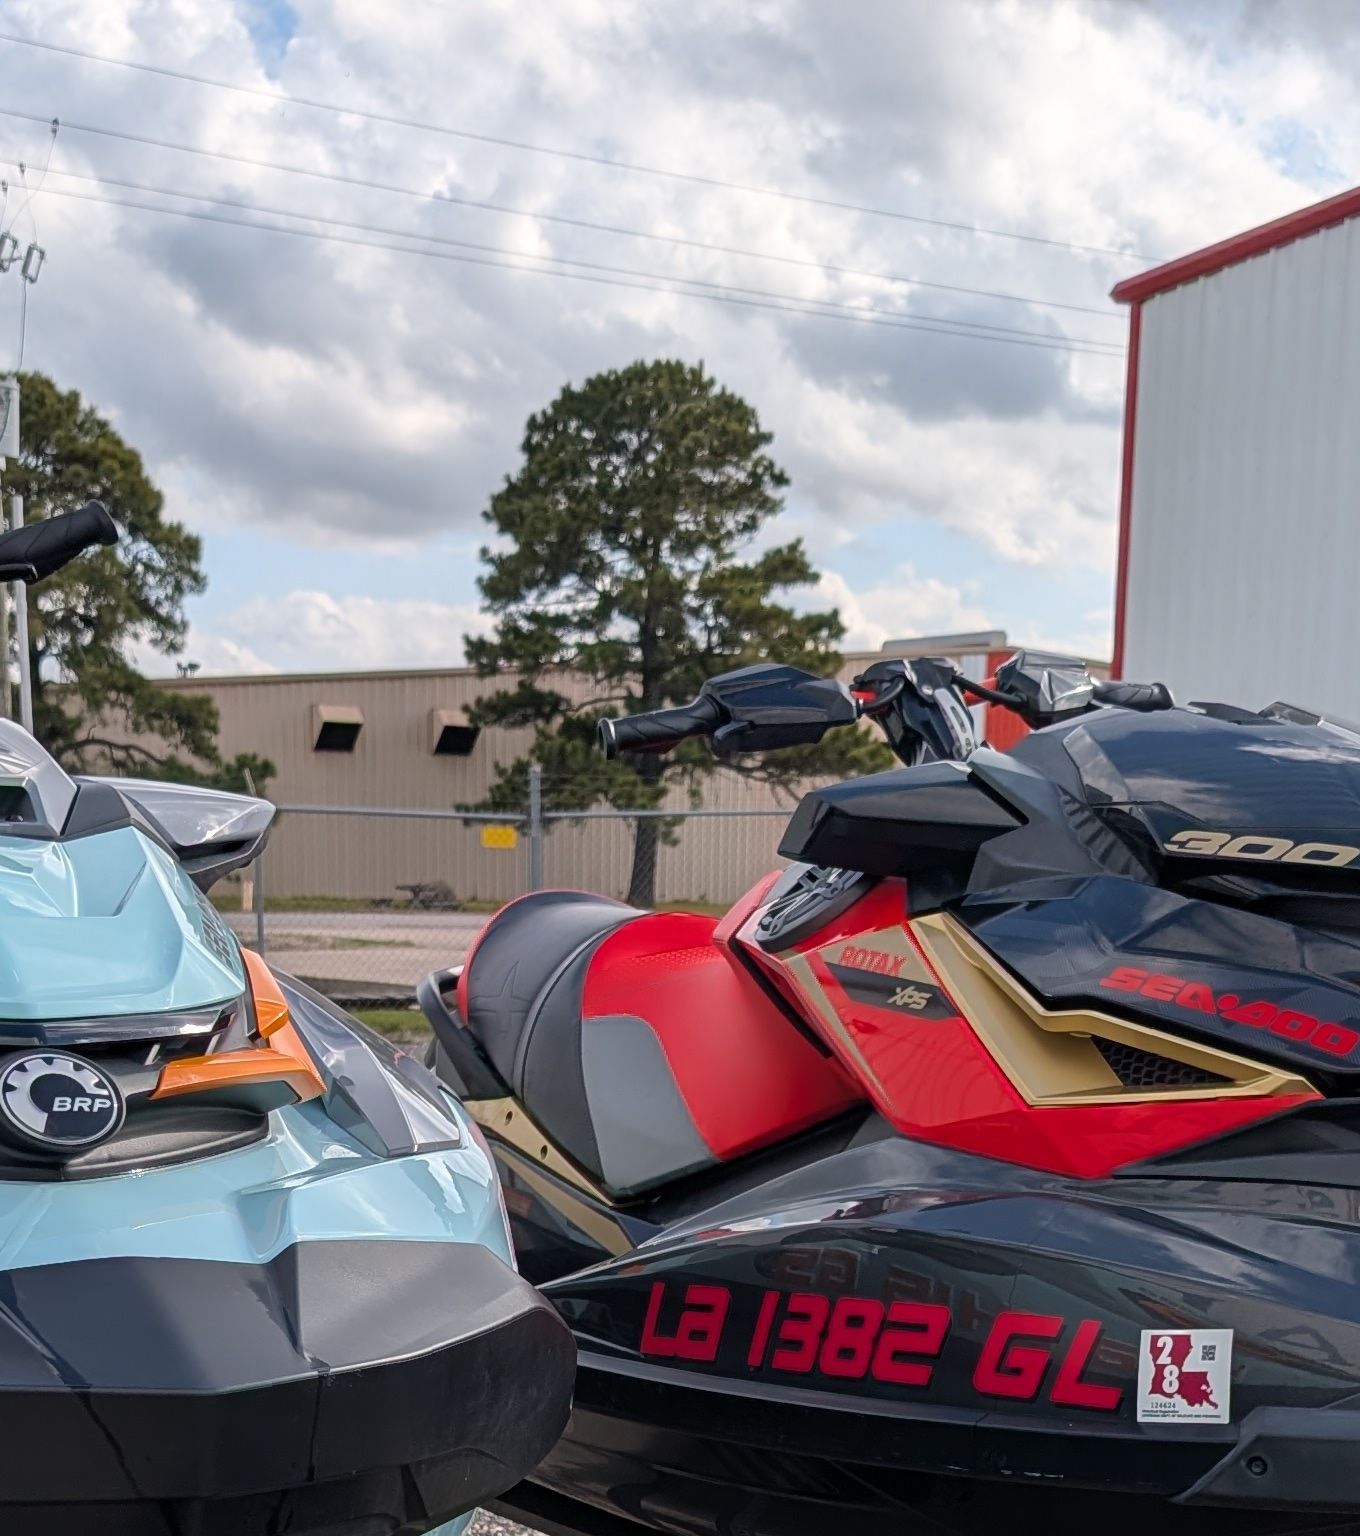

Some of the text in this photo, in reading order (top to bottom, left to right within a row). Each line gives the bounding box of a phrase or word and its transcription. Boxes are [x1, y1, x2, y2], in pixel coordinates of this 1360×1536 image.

[1164, 830, 1360, 867] 300
[839, 946, 907, 977] ROTAX
[887, 986, 933, 1010] XPS
[52, 1096, 112, 1113] BRP
[747, 1289, 952, 1388] 1382
[972, 1310, 1125, 1411] GL
[1156, 1335, 1174, 1365] 2
[1161, 1364, 1180, 1394] 8
